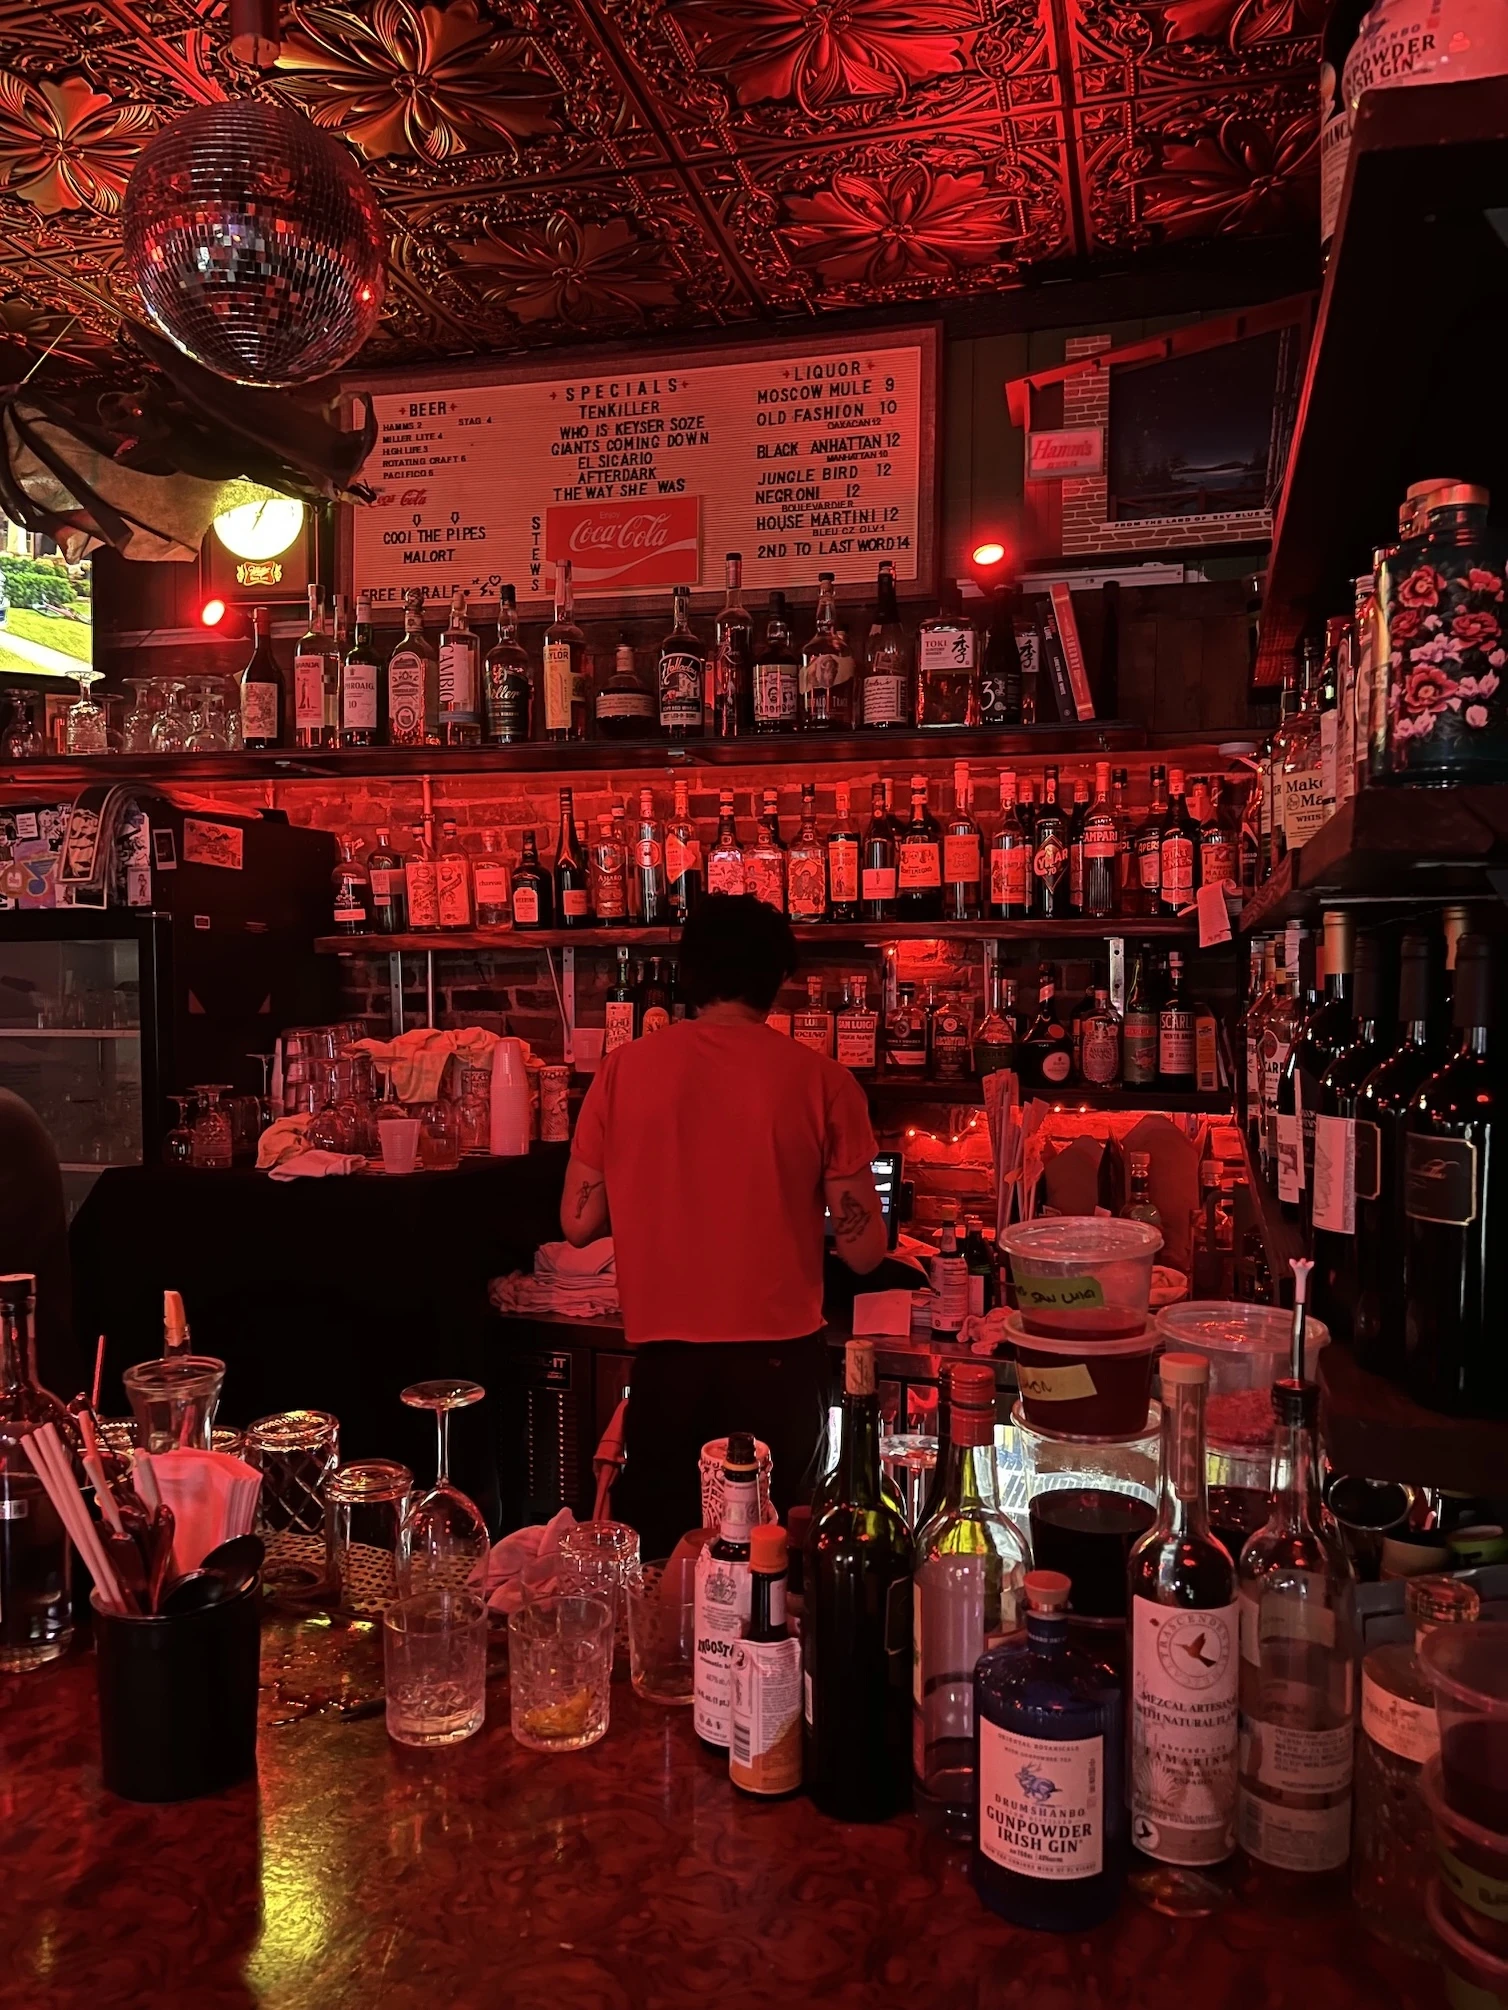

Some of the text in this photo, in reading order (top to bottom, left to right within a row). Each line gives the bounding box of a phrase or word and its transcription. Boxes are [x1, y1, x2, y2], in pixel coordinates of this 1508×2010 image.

[1380, 54, 1414, 78] GIN
[794, 361, 861, 381] LIQUOR
[566, 378, 678, 402] SPECIALS
[757, 377, 895, 405] MOSCOW MULE 9
[409, 401, 447, 417] BEER
[578, 401, 660, 420] TENKILLER
[756, 400, 897, 427] OLD FASHION 10
[383, 422, 414, 432] HAMMS
[458, 416, 492, 426] STAG 4
[560, 415, 706, 441] WHO IS KEYSER SOZE
[827, 419, 871, 430] OAXACAN
[382, 432, 443, 443] MILLER LITE 4
[551, 431, 709, 457] GIANTS COMING DOWN
[757, 432, 901, 460] BLACK ANHATTAN 12
[382, 445, 428, 456] HIGH LIFE 3
[826, 451, 877, 463] MANHATTAN
[1030, 438, 1094, 461] Hamm's
[382, 454, 466, 468] ROTATING CRAFT 6
[578, 452, 654, 470] EL SICARIO
[383, 470, 426, 480] PACIFICO
[578, 466, 657, 485] AFTERDARK
[757, 463, 892, 486] JUNGLE BIRD 12
[553, 478, 686, 502] THE WAY SHE WAS
[755, 483, 861, 505] NEGRONI 12
[781, 500, 855, 513] BOULEVARDIER
[756, 507, 899, 532] HOUSE MARTINI 12
[1114, 511, 1260, 529] FROM THE LAND OF SKY BLUE
[417, 528, 442, 543] THE
[446, 526, 486, 542] PIPES
[569, 512, 672, 553] Coca-Cola
[812, 528, 838, 537] BLEU
[841, 526, 855, 535] CZ
[859, 524, 878, 533] OLV
[403, 548, 457, 564] MALORT
[757, 536, 910, 559] 2ND TO LAST WORD 14
[361, 585, 460, 602] FREE MRALE
[925, 640, 948, 648] TOKI
[348, 700, 357, 709] 10
[1301, 794, 1323, 808] Ma
[1296, 814, 1321, 822] WHIS
[1083, 831, 1118, 842] AMPARI
[851, 1017, 874, 1029] LUIGI
[1161, 1013, 1194, 1030] SCARL
[1031, 1291, 1057, 1304] SAN
[1141, 1691, 1187, 1712] MEZCAL
[1136, 1703, 1160, 1720] WITH
[1163, 1714, 1215, 1728] NATURAL
[995, 1793, 1086, 1818] DRUMSHANBO
[986, 1804, 1092, 1838] GUNPOWDER
[998, 1826, 1078, 1853] IRISH GIN
